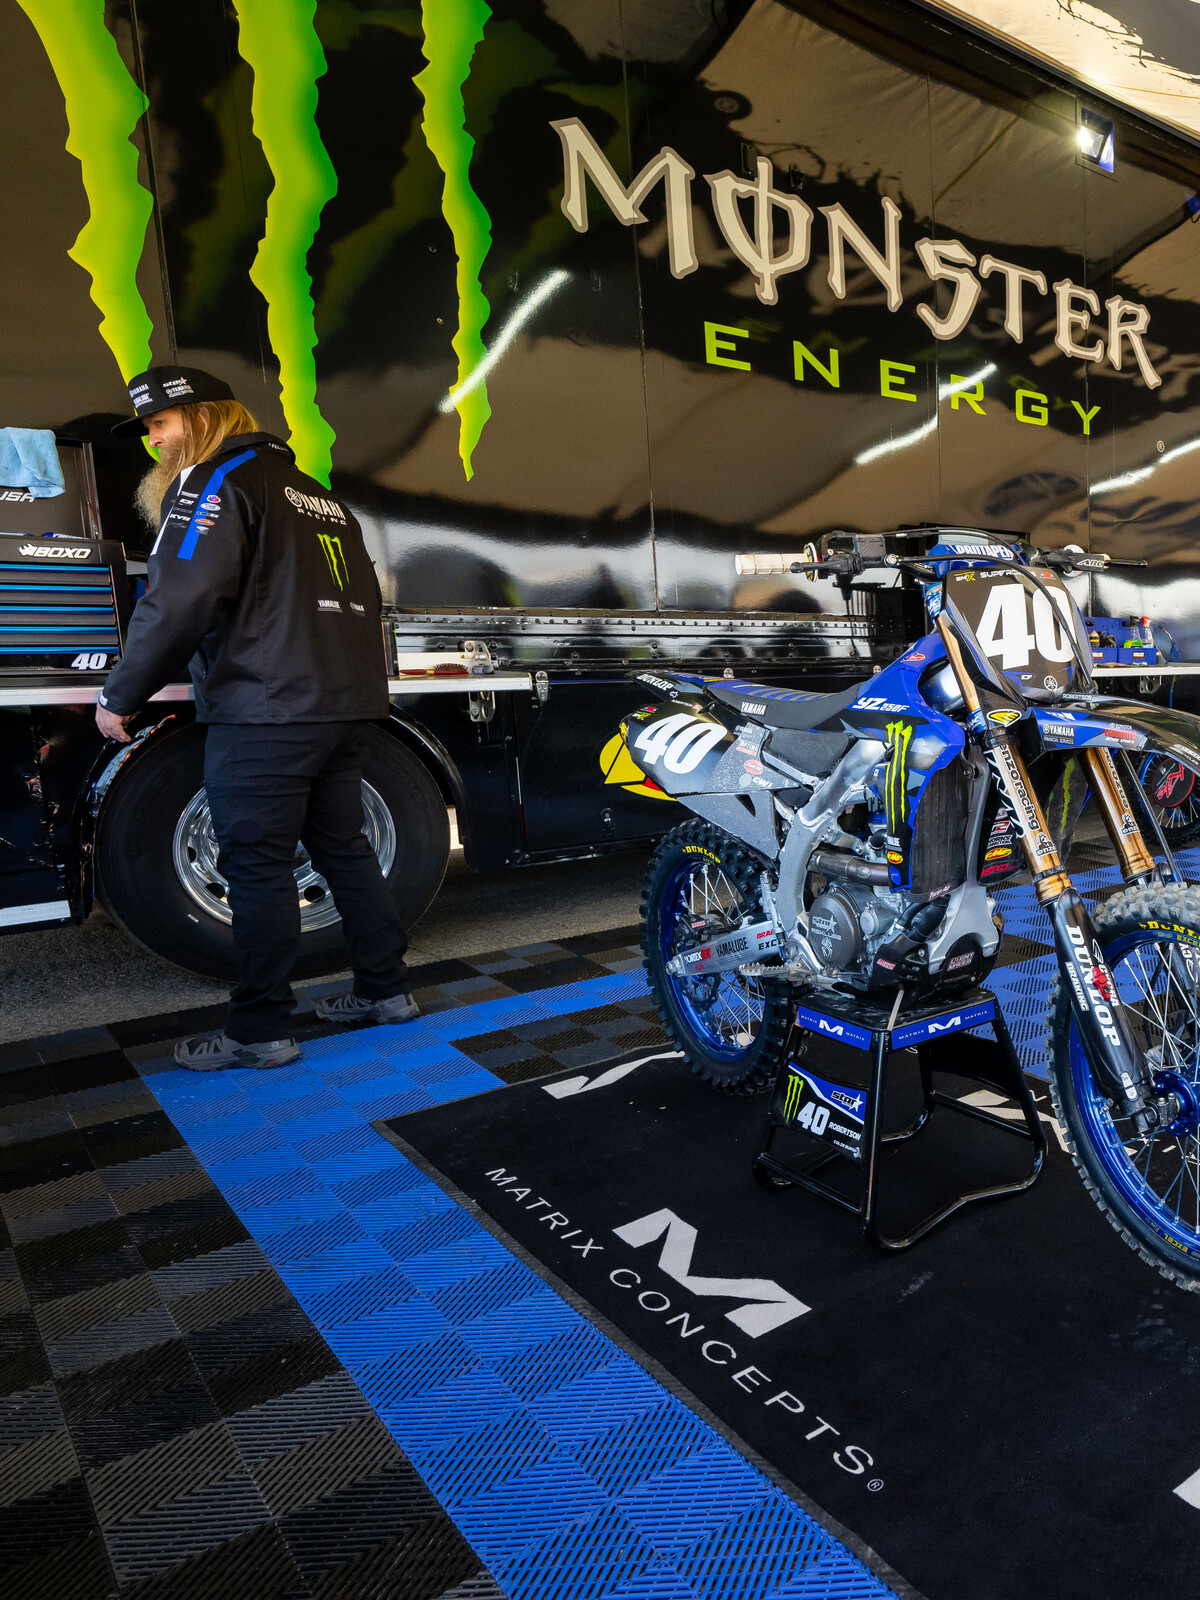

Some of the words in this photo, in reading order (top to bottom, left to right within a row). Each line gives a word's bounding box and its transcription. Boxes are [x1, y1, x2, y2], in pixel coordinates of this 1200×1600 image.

[549, 117, 1162, 390] MONSTER
[704, 321, 1102, 436] ENERGY
[298, 493, 347, 521] YAMAHA
[298, 508, 347, 526] RACING
[35, 547, 92, 560] BOXO
[975, 583, 1077, 670] 40
[71, 653, 108, 671] 40
[636, 673, 675, 691] DUNLOP
[741, 701, 767, 716] YAMAHA
[852, 697, 888, 711] YZ
[880, 703, 910, 713] 250F
[1062, 693, 1093, 701] ROBERTSON
[1049, 724, 1075, 737] YAMAHA
[633, 712, 728, 774] 40
[684, 845, 721, 864] DUNLOP
[715, 936, 749, 958] YAMALUBE
[758, 939, 788, 951] EXCE
[1065, 924, 1121, 1046] DUNLOP
[1065, 961, 1090, 1012] BRAKING
[818, 1018, 844, 1036] M
[845, 1031, 865, 1042] MATRIX
[898, 1029, 925, 1041] MATRIX
[928, 1016, 962, 1034] M
[964, 1010, 988, 1021] MATRIX
[796, 1101, 831, 1136] 40
[828, 1120, 862, 1141] ROBERTSON
[484, 1167, 604, 1259] MATRIX
[1163, 1233, 1189, 1254] EXCEL
[611, 1207, 813, 1339] M
[608, 1267, 876, 1477] CONCEPTS
